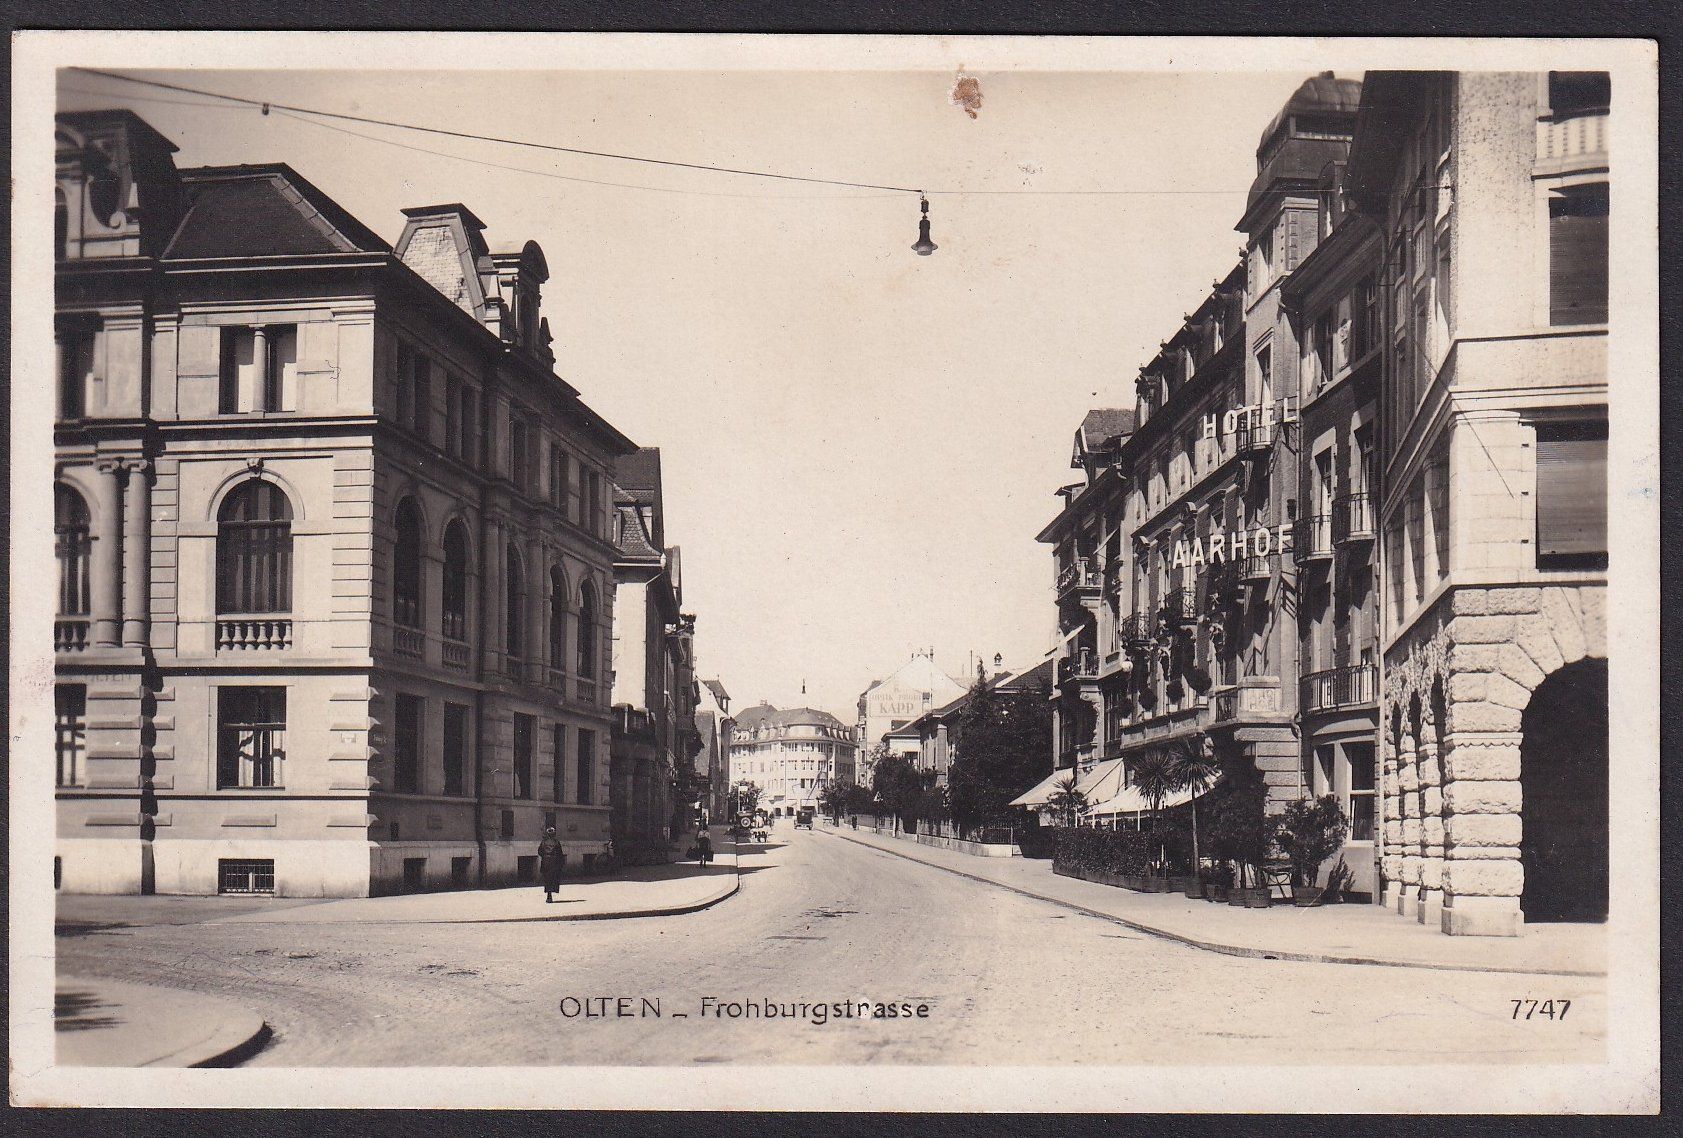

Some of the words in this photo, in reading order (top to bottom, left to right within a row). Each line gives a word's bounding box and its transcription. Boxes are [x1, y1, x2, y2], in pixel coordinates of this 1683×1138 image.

[1203, 397, 1298, 439] HOTEL
[1172, 523, 1294, 570] AARHOF
[879, 702, 914, 714] KAPP
